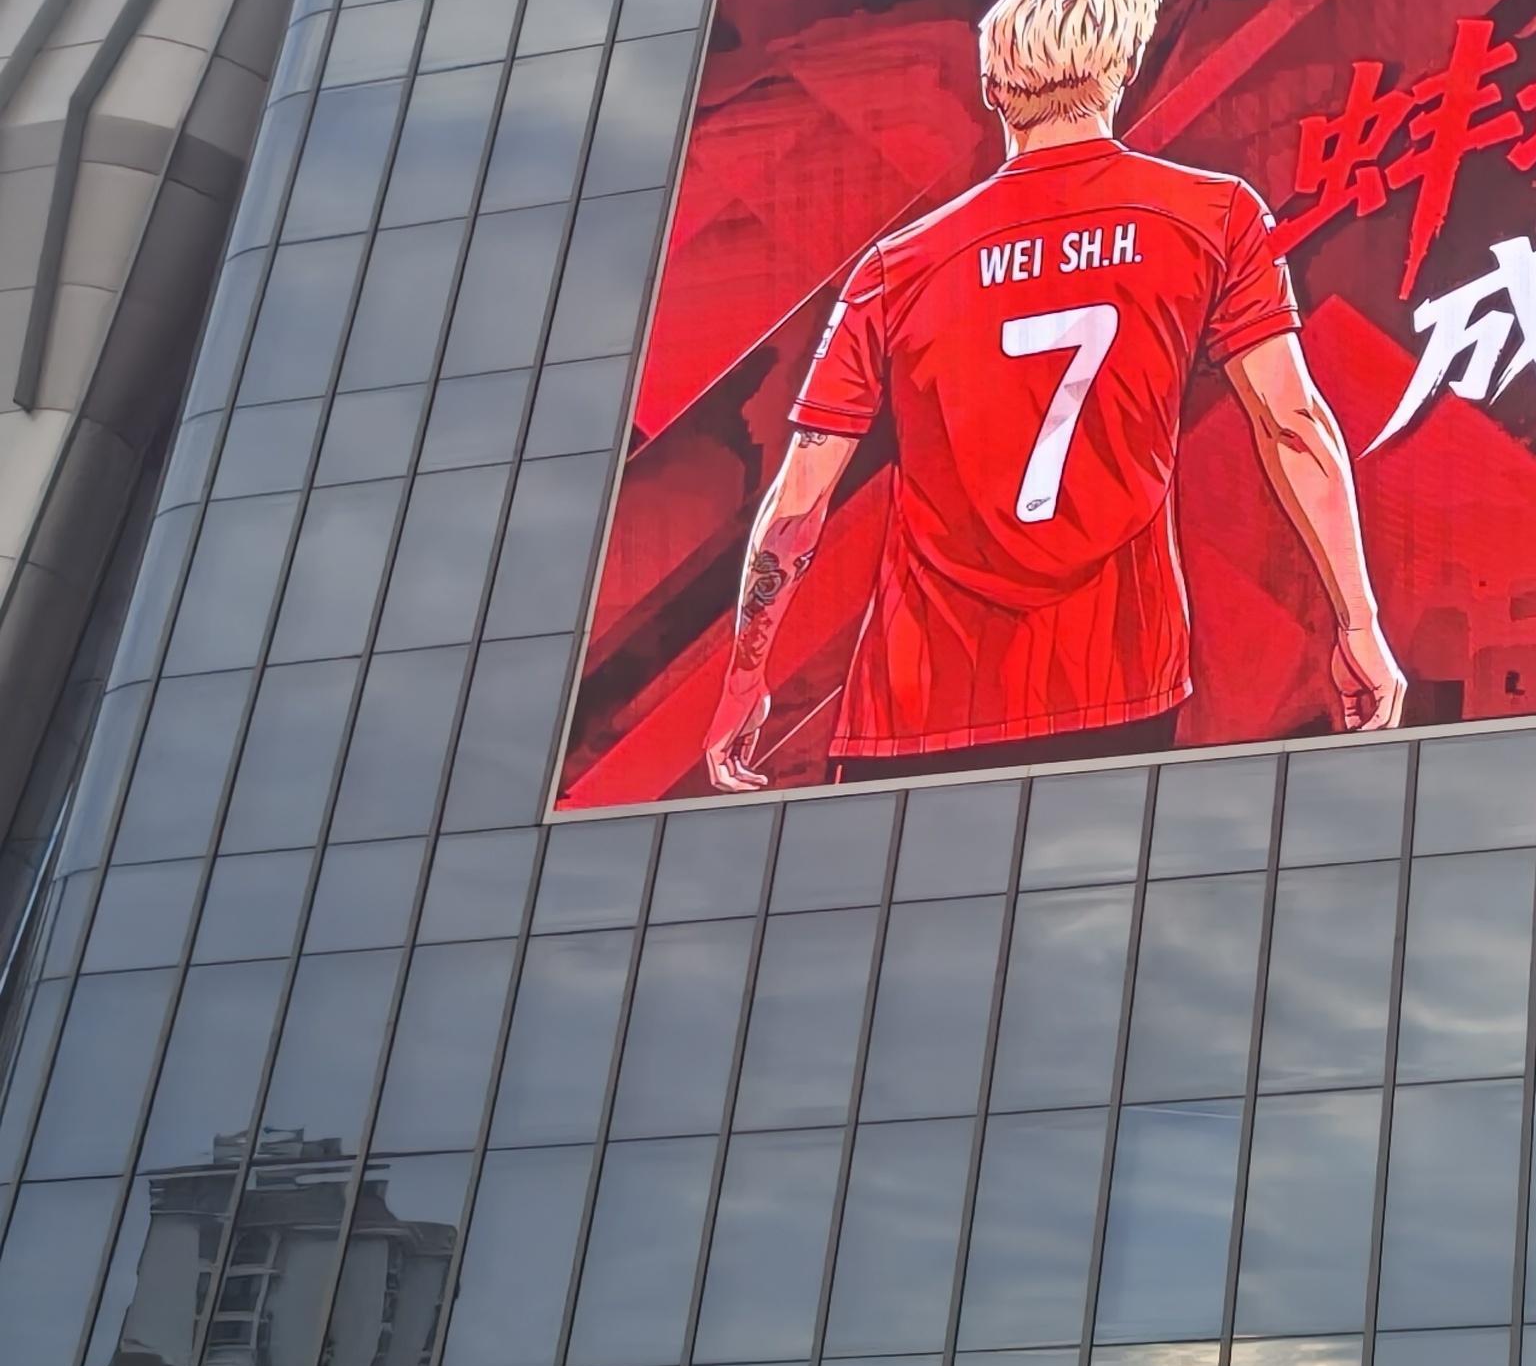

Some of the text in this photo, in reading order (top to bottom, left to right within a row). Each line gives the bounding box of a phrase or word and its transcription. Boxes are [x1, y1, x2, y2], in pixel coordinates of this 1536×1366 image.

[979, 222, 1143, 287] WEI SH.H.
[1001, 303, 1119, 522] 7
